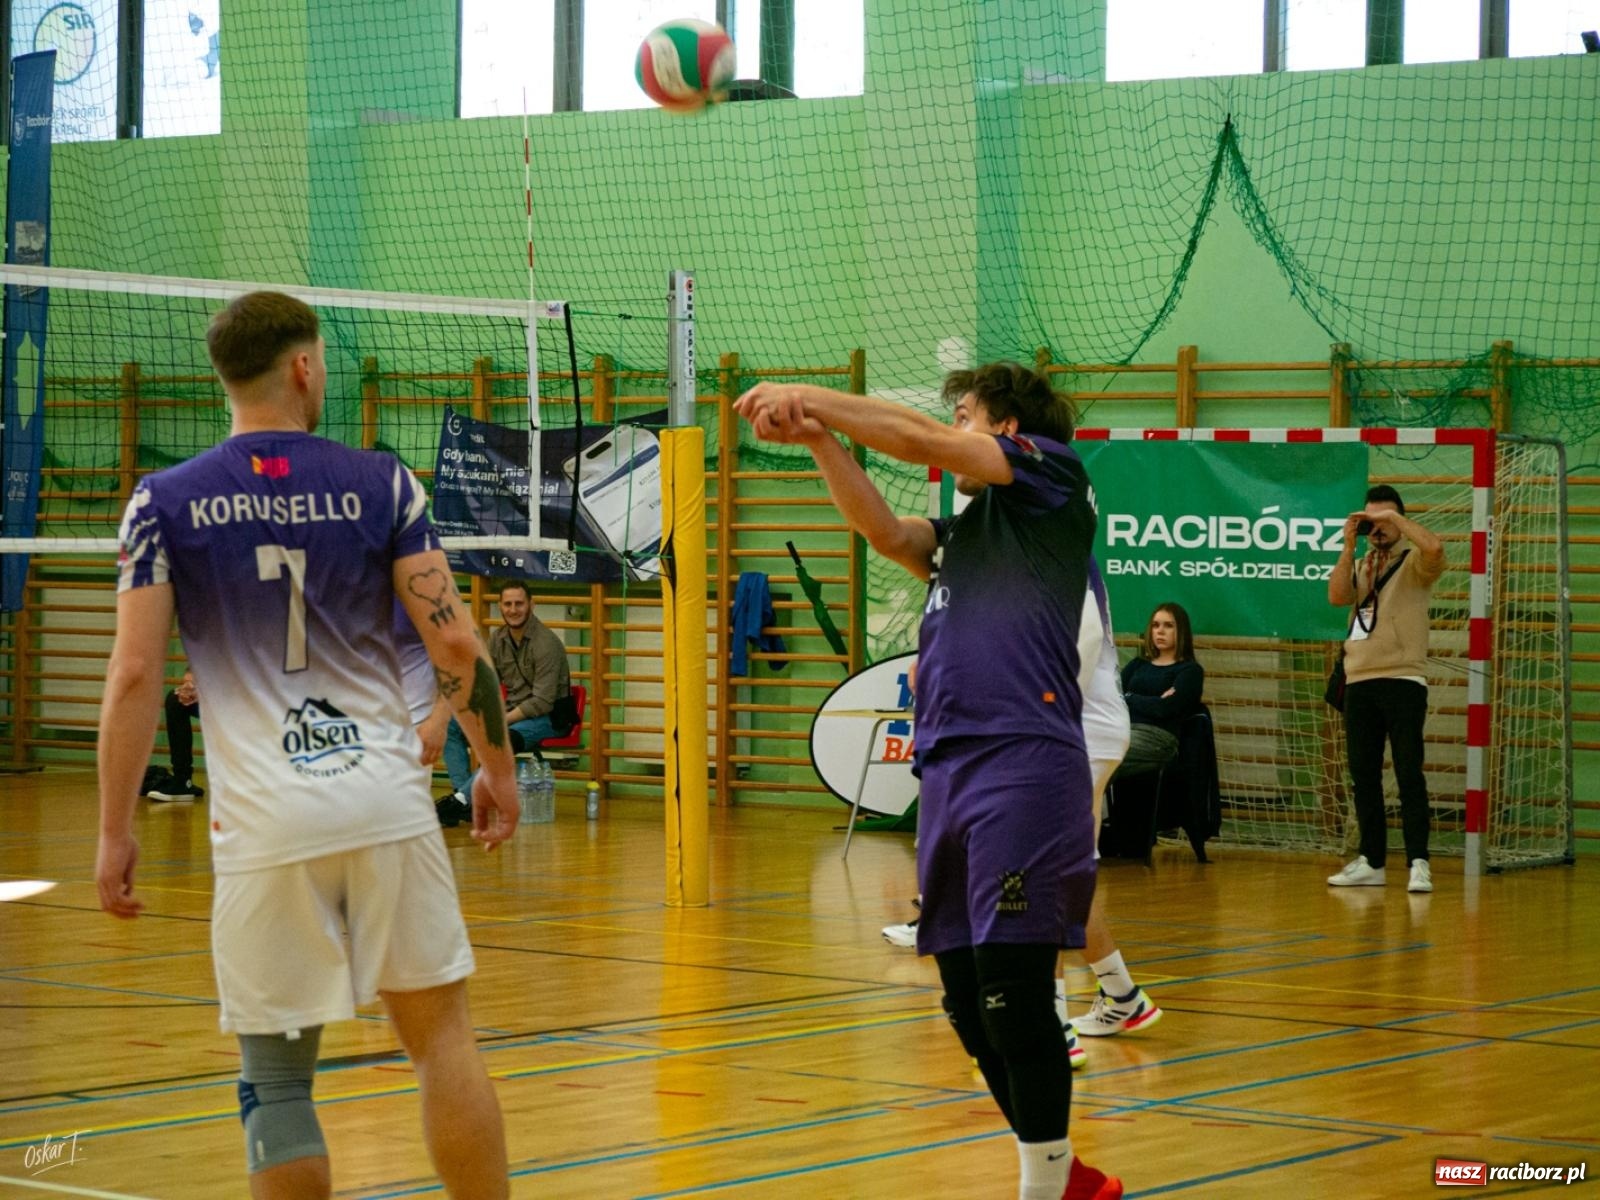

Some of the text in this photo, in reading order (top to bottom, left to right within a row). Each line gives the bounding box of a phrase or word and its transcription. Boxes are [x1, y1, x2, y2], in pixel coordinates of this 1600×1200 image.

[443, 448, 464, 464] Gdy
[441, 464, 456, 480] My
[189, 491, 362, 529] KORUSELLO
[1106, 505, 1348, 553] RACIBÓRZ
[1106, 556, 1336, 581] BANK SPÓŁDZIELCZ
[255, 545, 308, 674] 7
[283, 722, 362, 754] olsen
[881, 737, 916, 762] BA
